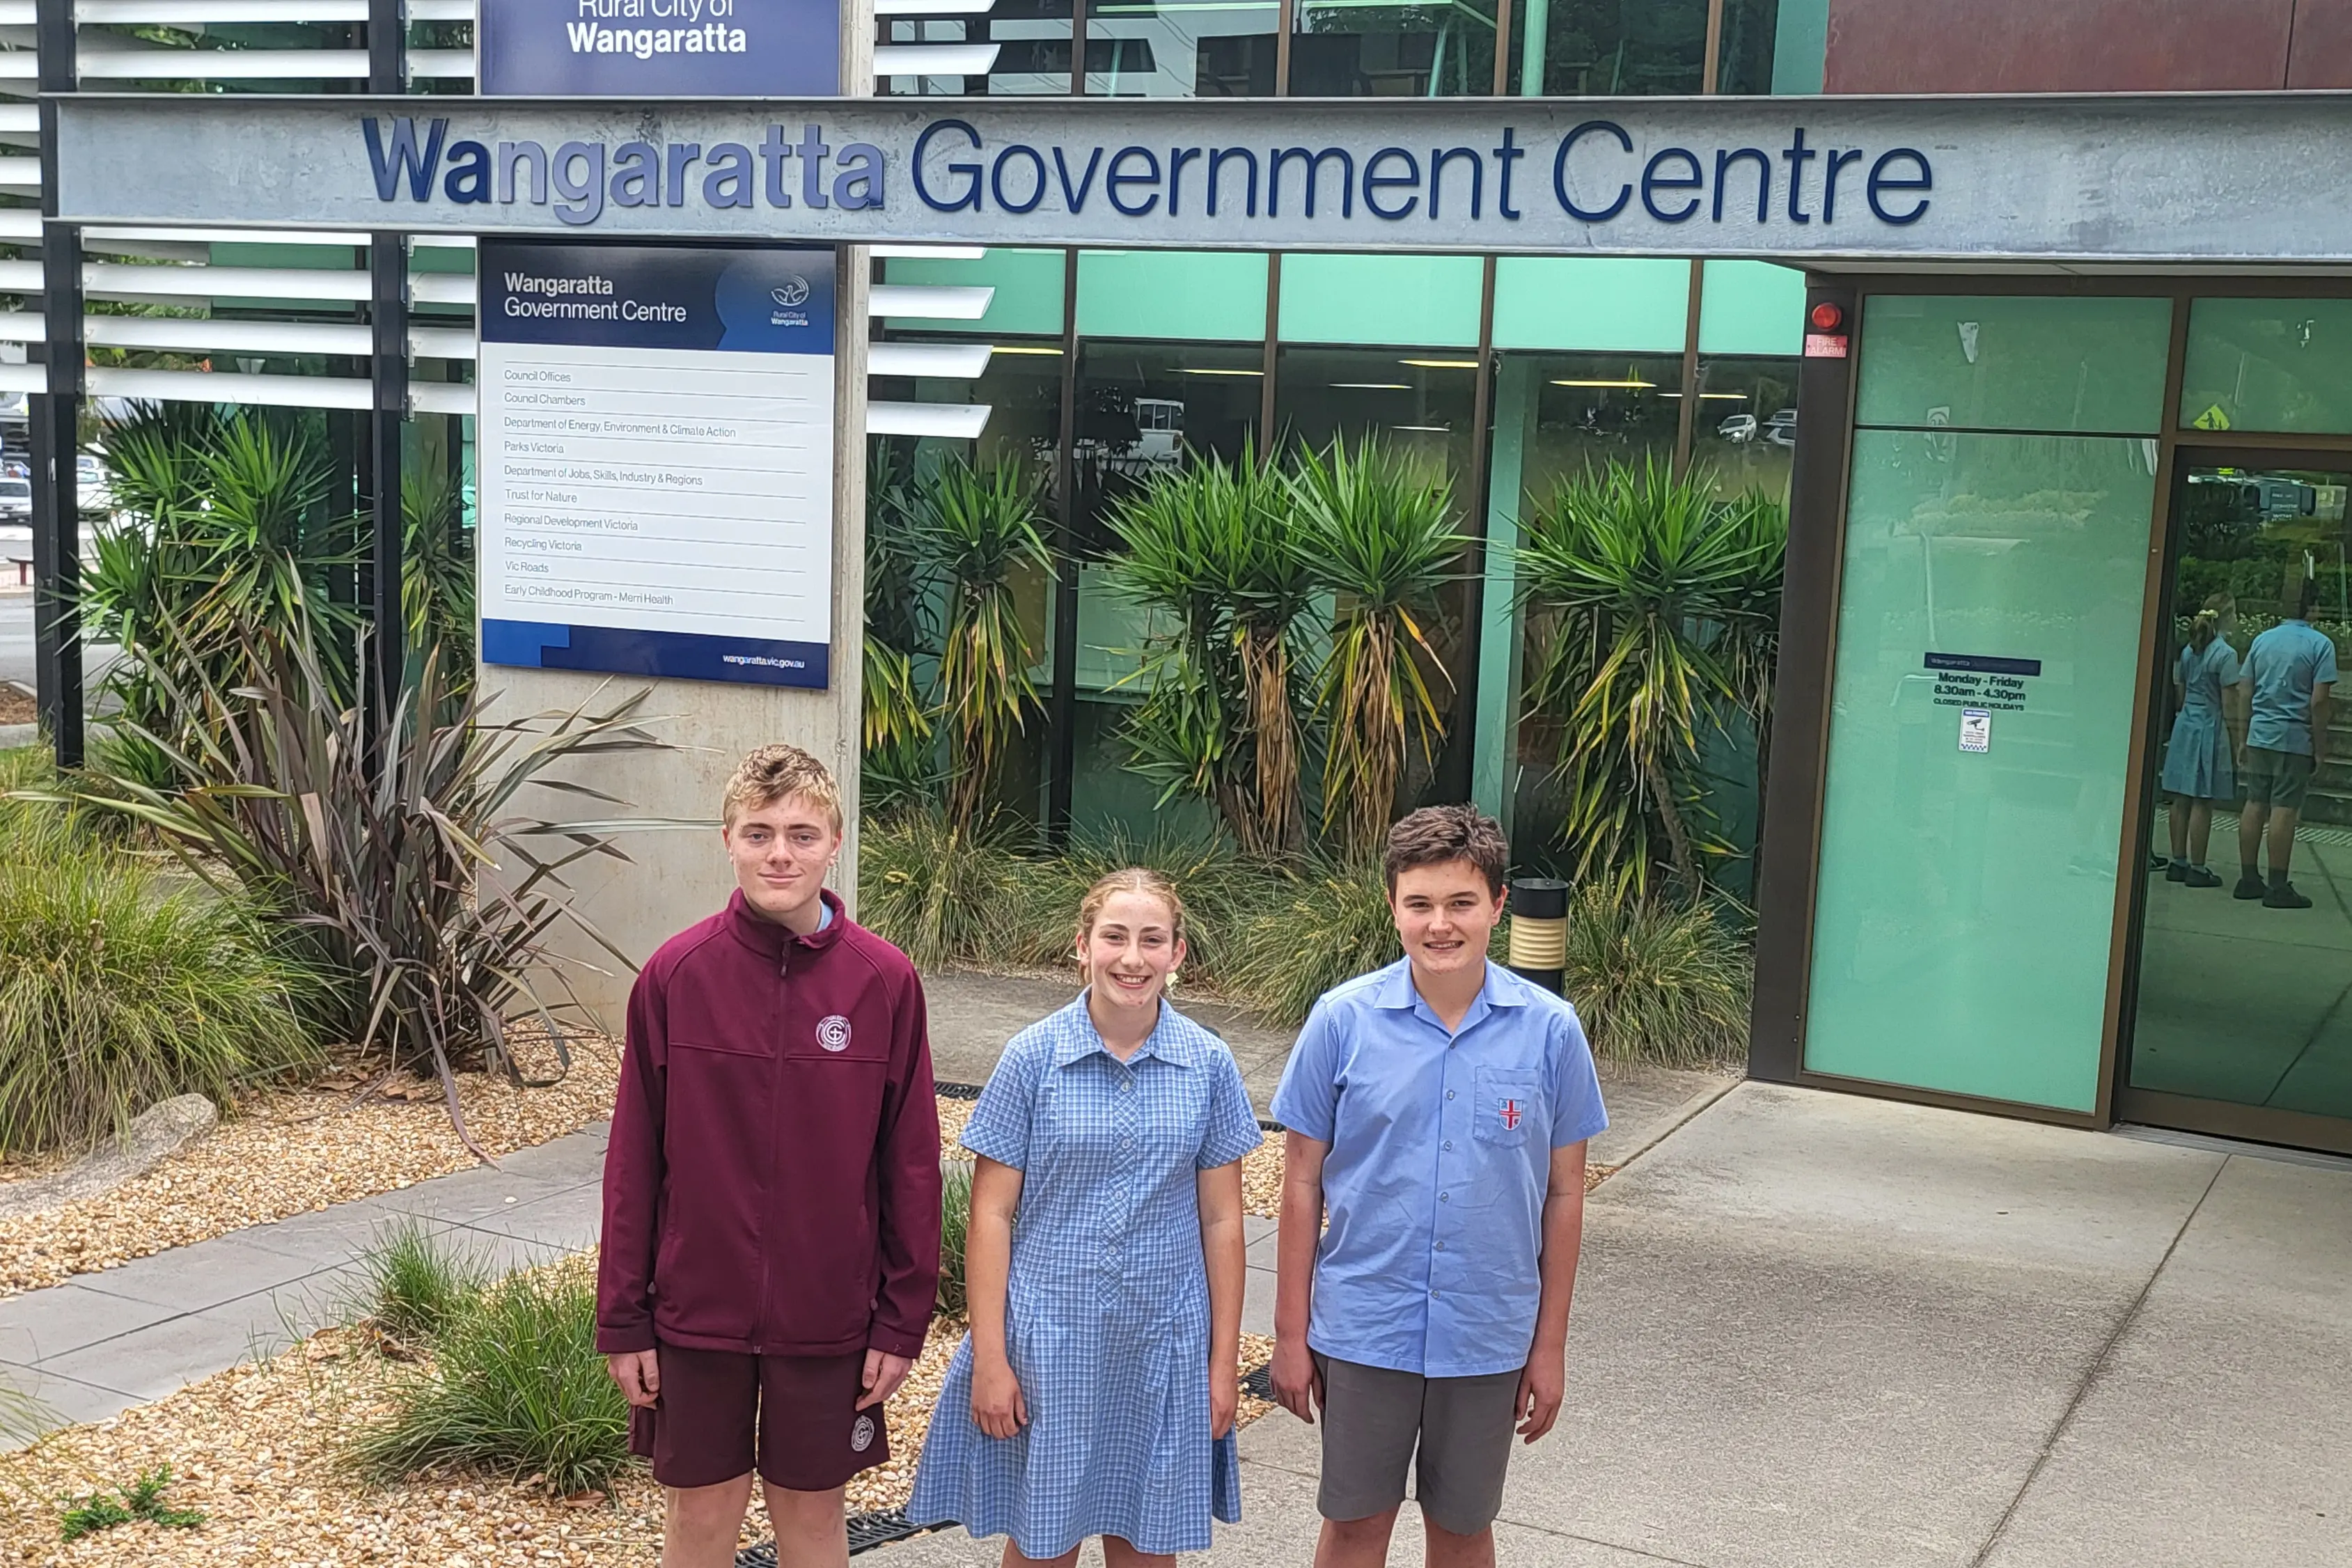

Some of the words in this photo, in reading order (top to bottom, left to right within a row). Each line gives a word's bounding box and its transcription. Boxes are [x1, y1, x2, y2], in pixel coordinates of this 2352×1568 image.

[579, 0, 644, 17] Rural
[566, 22, 747, 59] Wangaratta
[361, 117, 885, 226] Wangaratta
[912, 118, 1524, 221] Government
[1553, 120, 1932, 226] Centre
[504, 272, 613, 297] Wangaratta
[504, 296, 619, 320] Government
[622, 299, 687, 322] Centre
[1817, 338, 1837, 346] FIRE
[1811, 347, 1842, 355] ALARM
[504, 370, 538, 381] Council
[539, 371, 571, 382] Offices
[504, 392, 538, 403] Council
[539, 394, 586, 405] Chambers
[504, 417, 556, 429] Department
[558, 419, 567, 429] of
[568, 420, 603, 433] Energy,
[604, 421, 661, 434] Environment
[662, 424, 668, 434] &
[670, 424, 705, 436] Climate
[706, 426, 736, 437] Action
[504, 441, 529, 452] Parks
[531, 442, 565, 454] Victoria
[504, 465, 556, 477] Department
[558, 468, 567, 478] of
[568, 469, 592, 480] Jobs,
[593, 469, 618, 482] Skills,
[619, 471, 656, 485] Industry
[657, 473, 664, 483] &
[665, 473, 703, 486] Regions
[505, 489, 529, 500] Trust
[531, 490, 544, 501] for
[545, 491, 577, 503] Nature
[504, 513, 542, 526] Regional
[544, 515, 603, 529] Development
[604, 518, 638, 531] Victoria
[504, 538, 547, 551] Recycling
[549, 539, 582, 551] Victoria
[505, 560, 519, 571] Vic
[521, 561, 549, 573] Roads
[505, 584, 527, 597] Early
[528, 586, 574, 599] Childhood
[574, 588, 613, 602] Program
[643, 593, 673, 605] Health
[723, 654, 805, 669] wangaratta.vic.gov.au
[1938, 672, 1982, 687] Monday
[1989, 675, 2025, 689] Friday
[1934, 684, 1975, 696] 8.30am
[1983, 687, 2026, 701] 4.30pm
[1963, 700, 1988, 708] PUBLIC
[1988, 702, 2025, 711] HOLIDAYS
